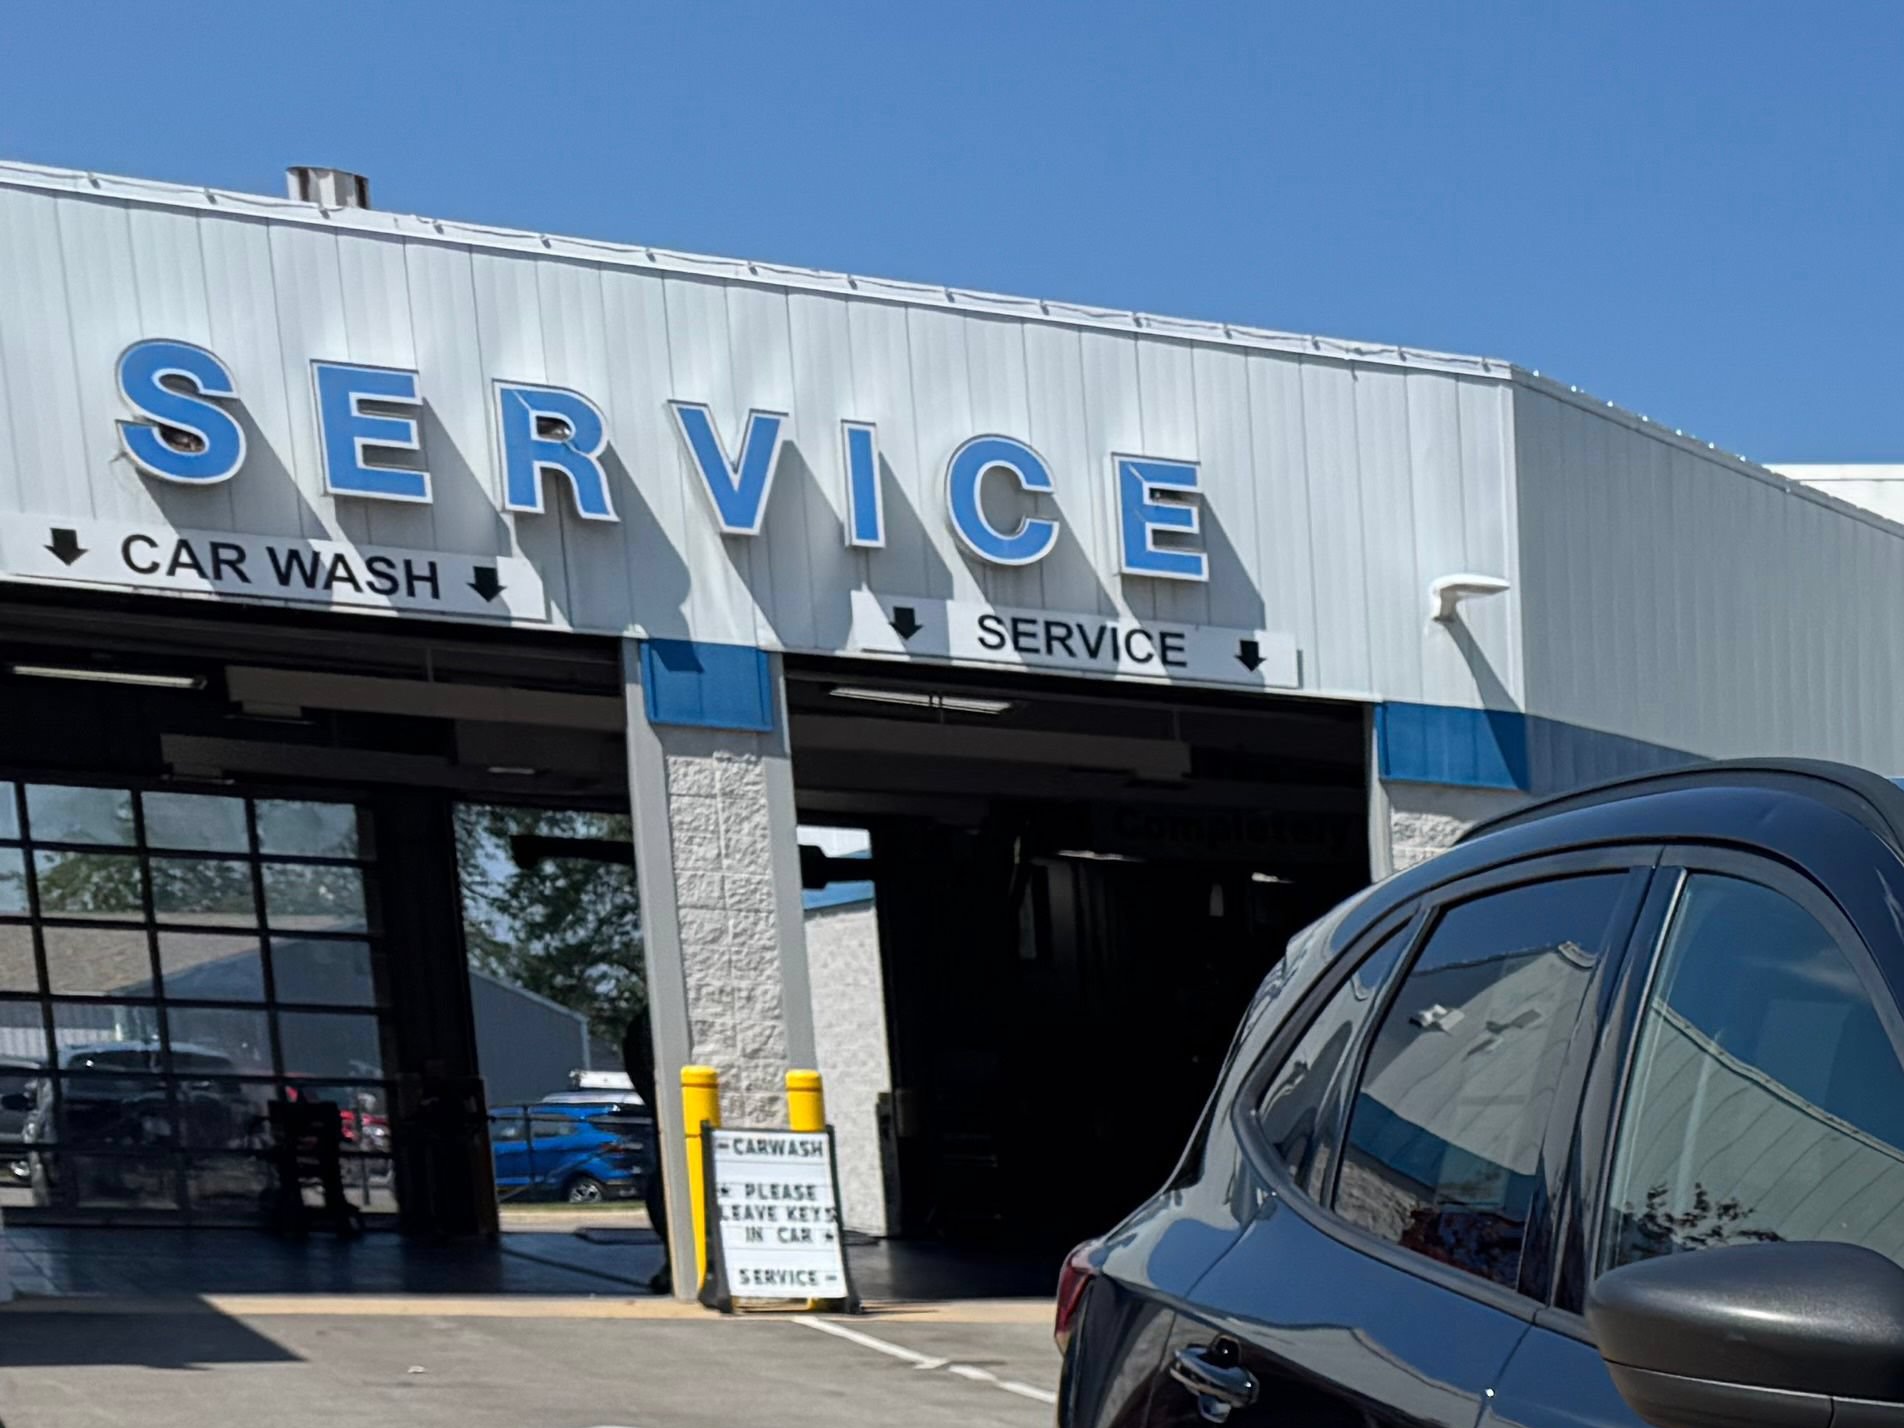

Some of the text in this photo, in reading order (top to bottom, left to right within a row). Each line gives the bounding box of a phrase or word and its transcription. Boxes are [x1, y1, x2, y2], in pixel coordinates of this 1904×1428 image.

[115, 337, 1210, 582] SERVICE
[121, 533, 441, 600] CAR WASH
[976, 615, 1187, 668] SERVICE
[733, 1138, 823, 1158] CARWASH
[745, 1184, 816, 1201] PLEASE
[720, 1204, 836, 1222] LEAVE KEYS
[745, 1227, 814, 1244] IN CAR
[739, 1269, 818, 1287] SERVICE
